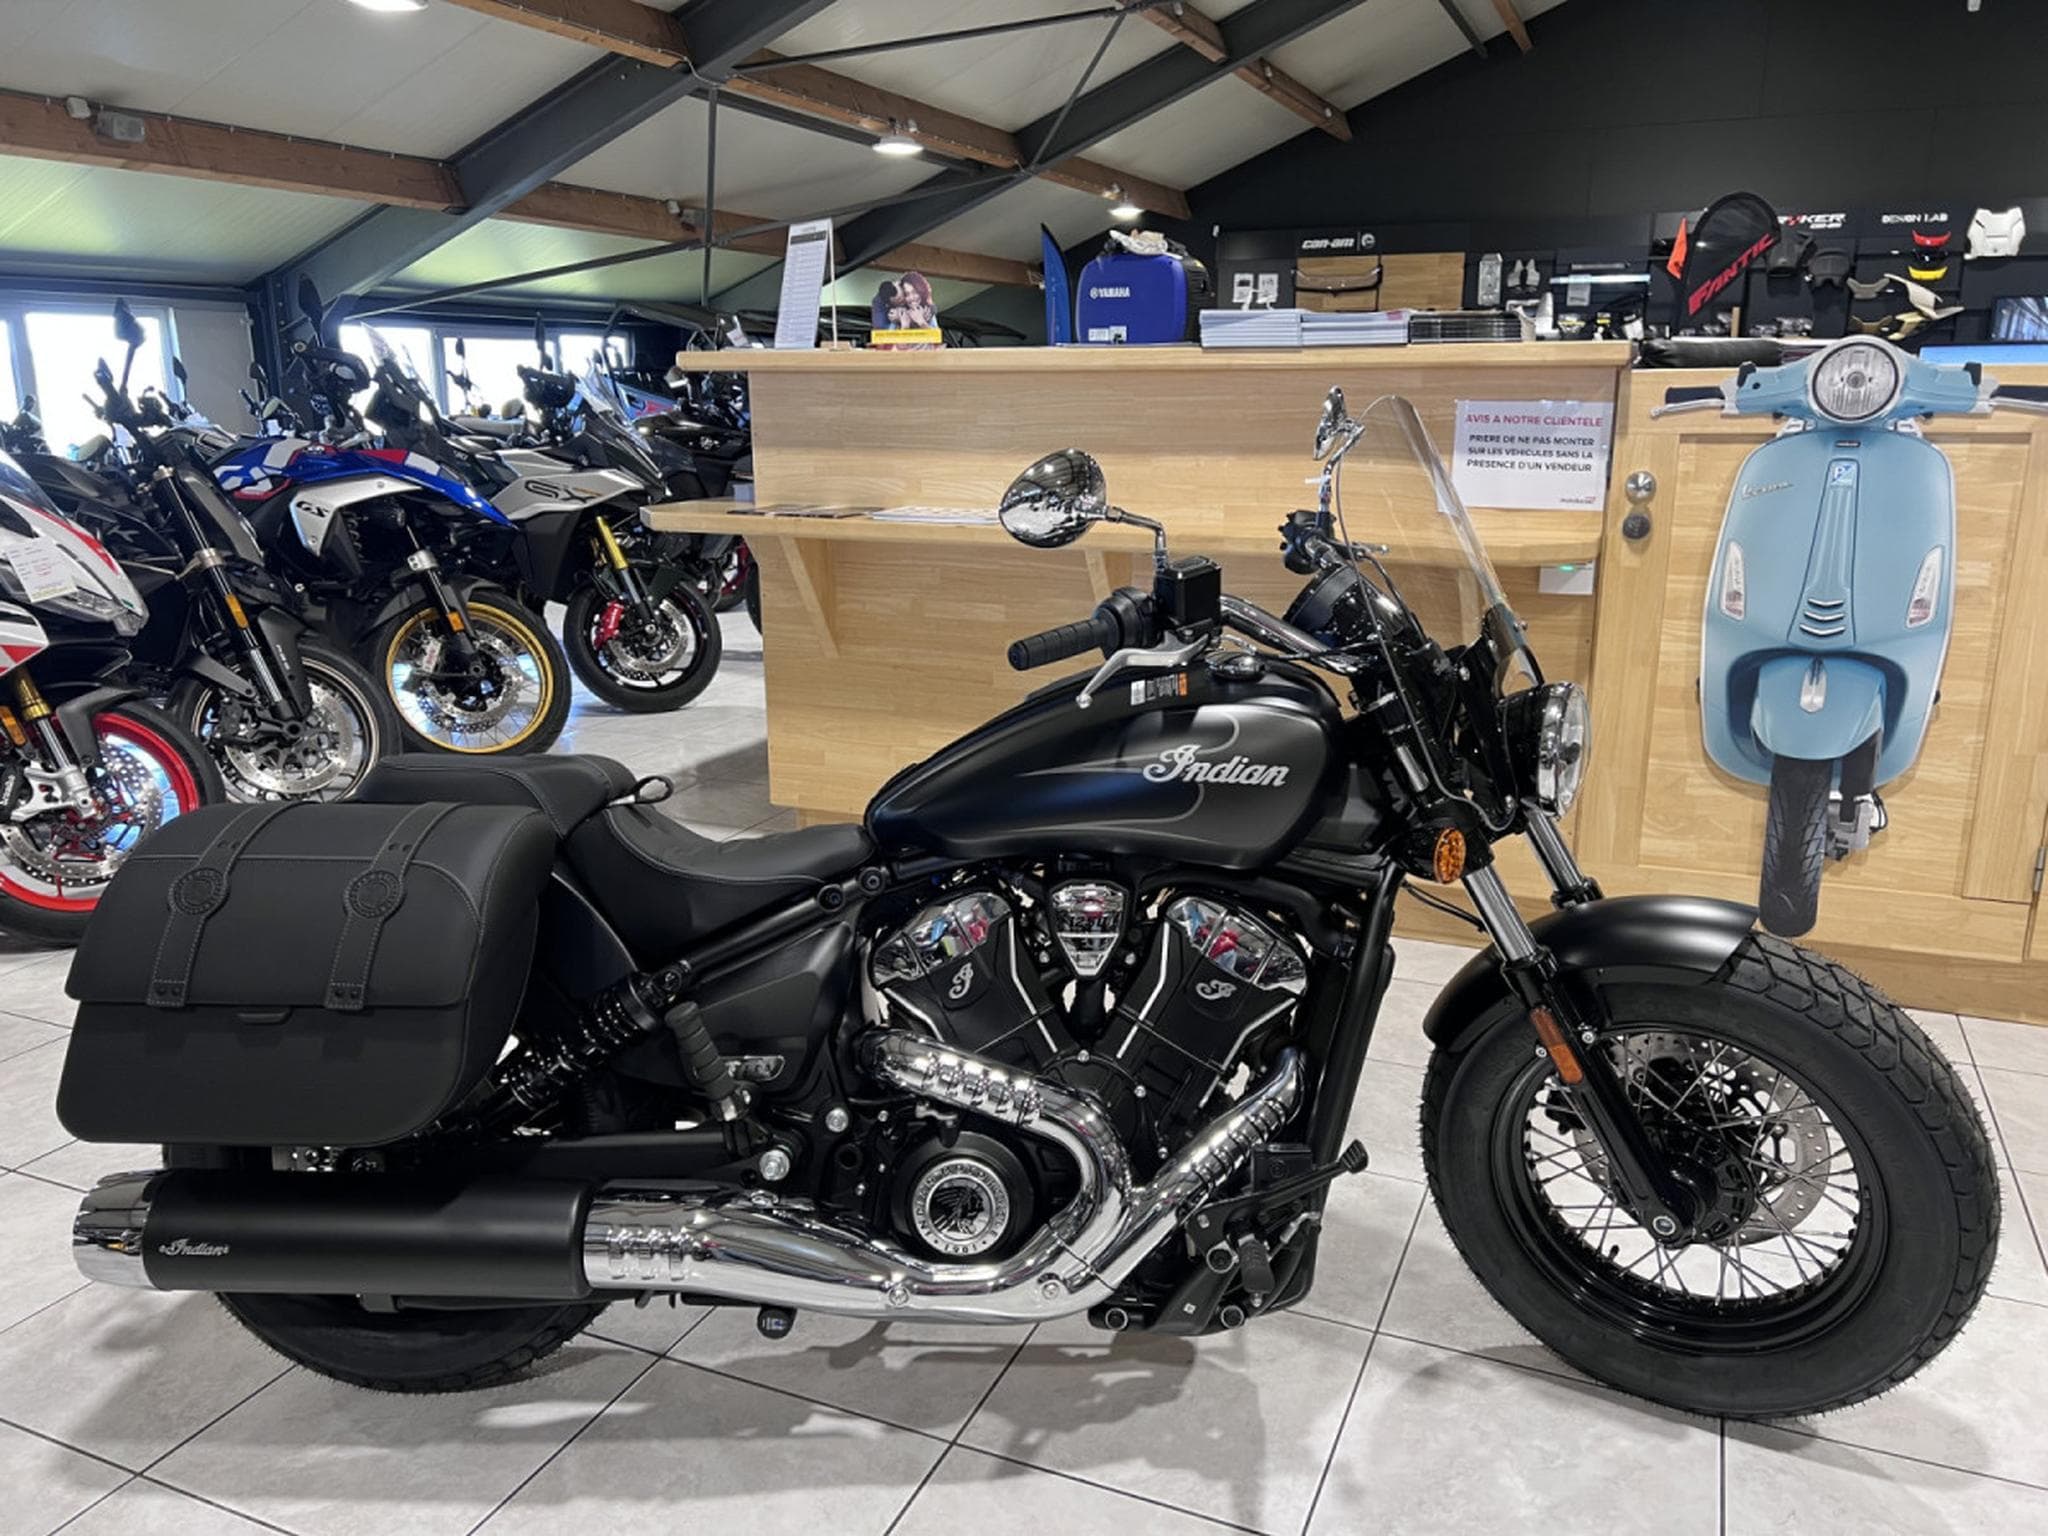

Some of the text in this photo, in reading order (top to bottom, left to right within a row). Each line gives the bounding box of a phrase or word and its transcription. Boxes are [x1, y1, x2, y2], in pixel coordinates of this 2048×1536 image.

[1688, 233, 1774, 315] FANTIC
[1099, 286, 1131, 298] YAMAHA
[1466, 414, 1603, 427] AVIS A NOTRE CLIENTELE
[1503, 435, 1514, 443] DE
[1518, 436, 1529, 444] NE
[1533, 436, 1551, 445] PAS
[1553, 437, 1595, 446] MONTER
[1468, 447, 1485, 455] SUR
[1505, 448, 1554, 458] VEHICULES
[1556, 450, 1579, 458] SANS
[1582, 451, 1593, 459] LA
[1467, 459, 1592, 472] PRESENCE D'UN VENDEUR
[1143, 745, 1290, 787] Indian
[164, 1238, 223, 1256] Indian
[944, 1243, 977, 1254] 1901
